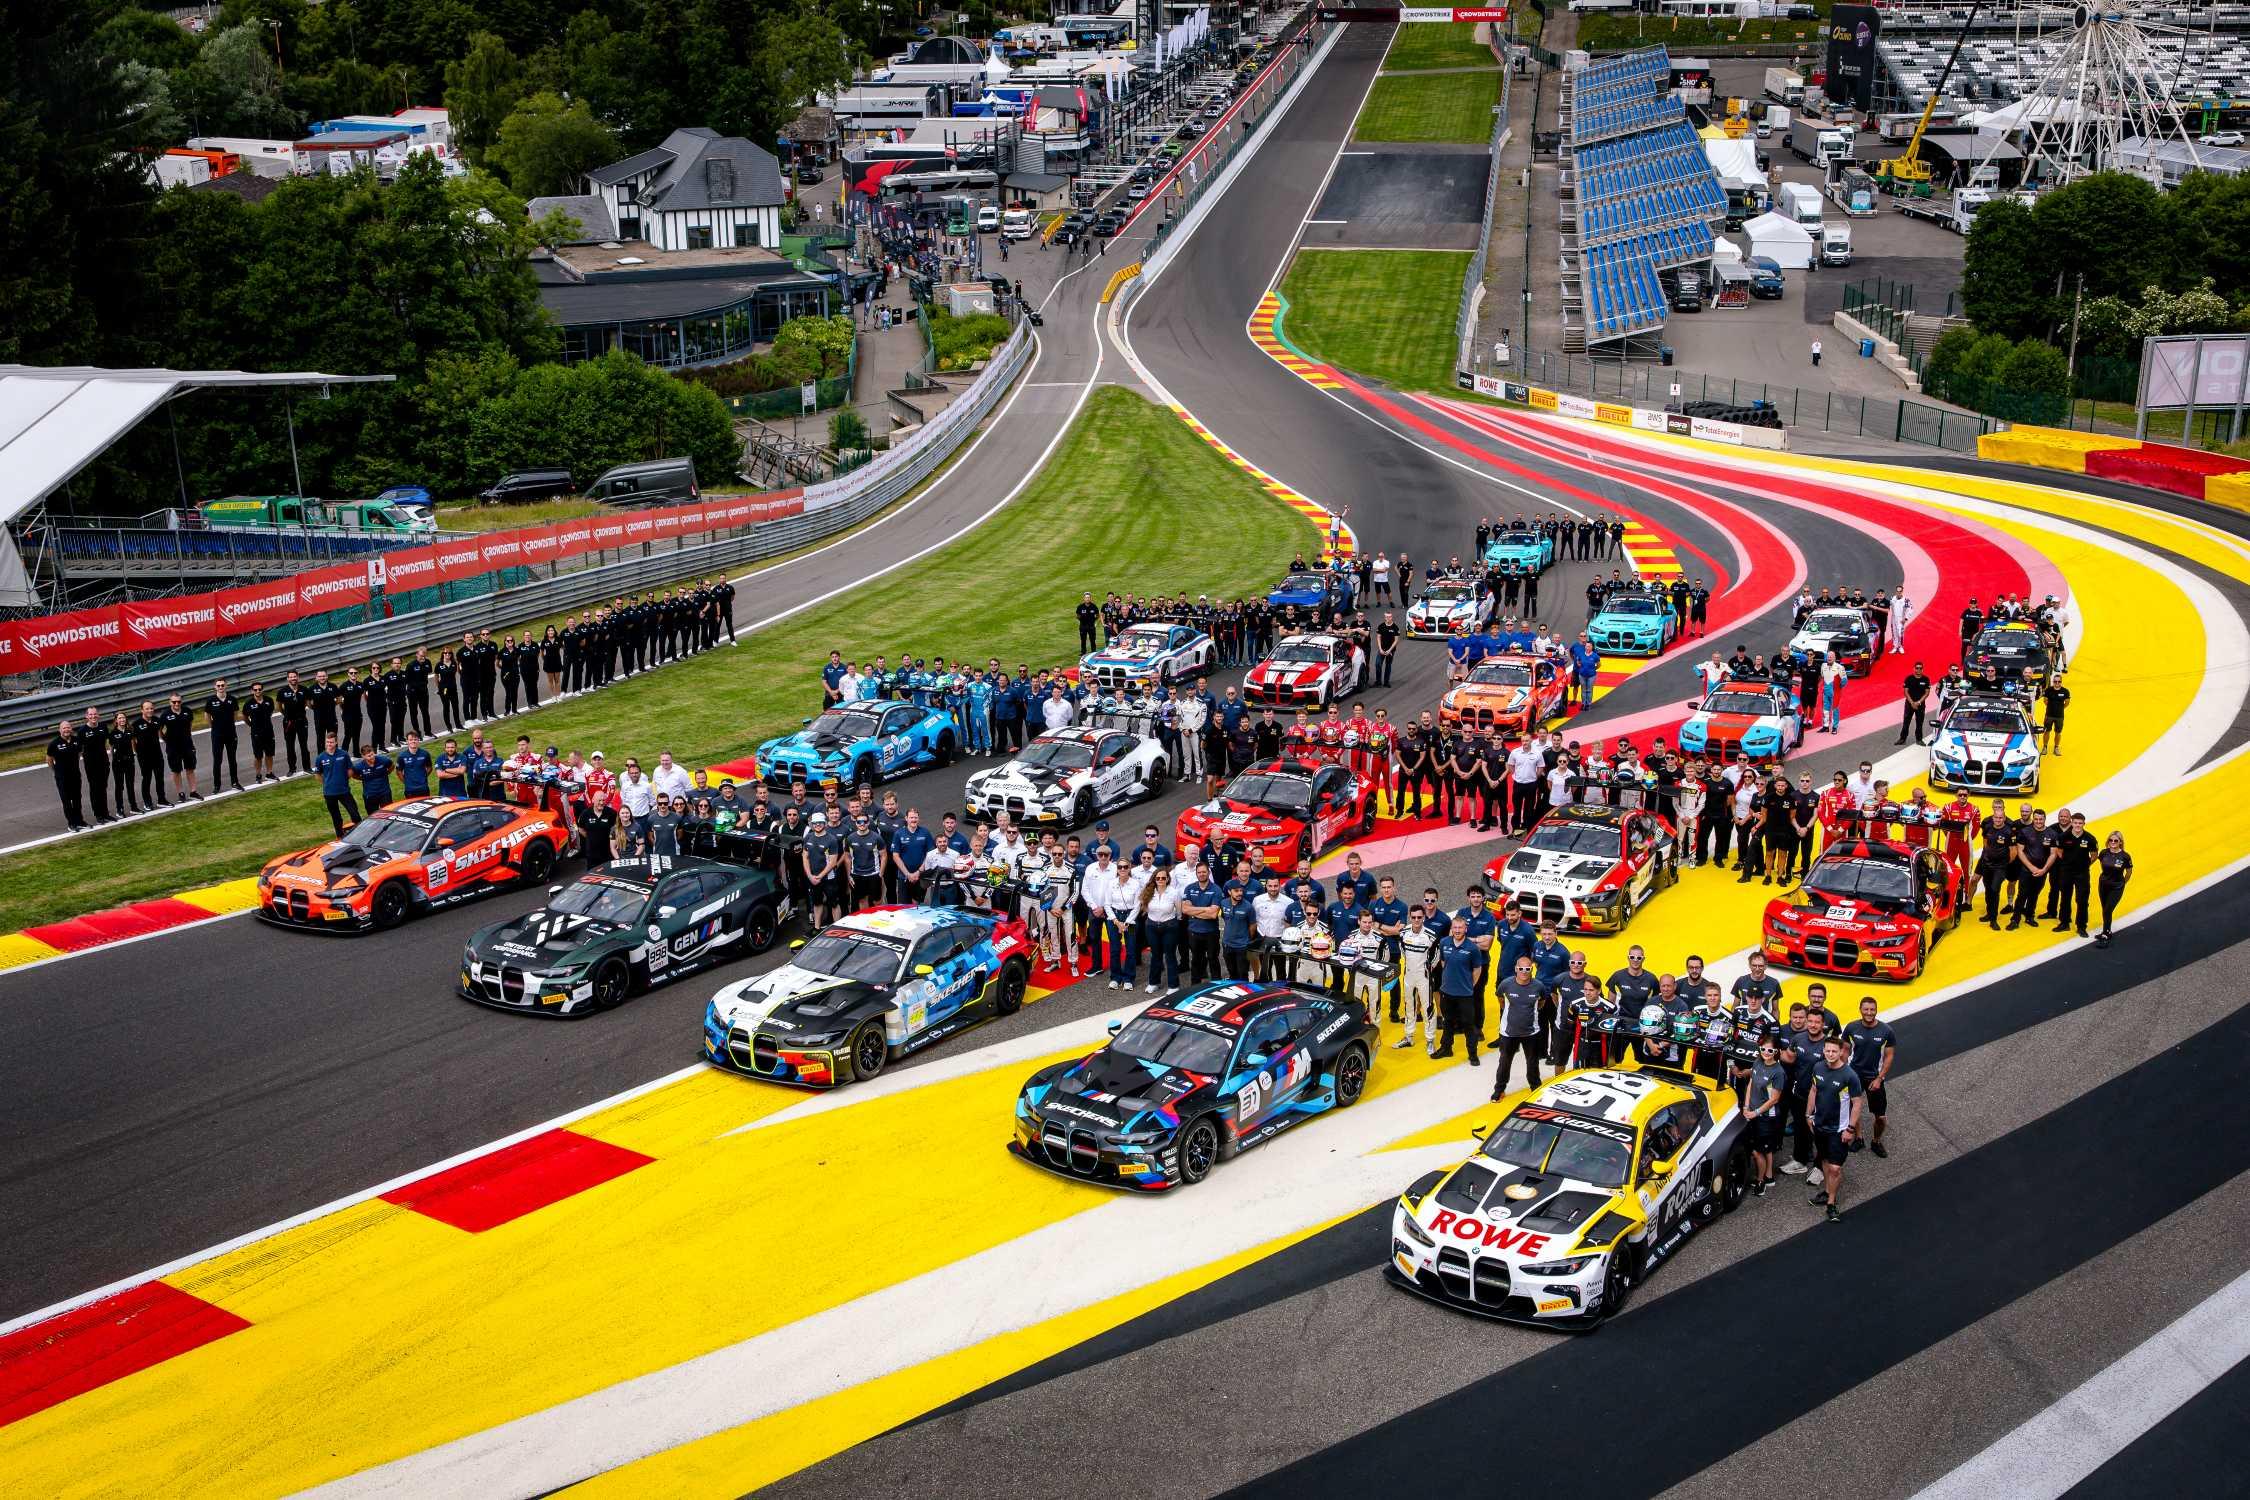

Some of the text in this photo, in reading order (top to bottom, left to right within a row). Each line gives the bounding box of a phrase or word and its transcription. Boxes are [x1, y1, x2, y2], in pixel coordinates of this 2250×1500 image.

[1479, 378, 1498, 391] ROWE
[1532, 392, 1555, 407] PIRELLI
[1598, 406, 1629, 422] PIRELLI
[440, 550, 479, 566] CROWDSTRIKE
[484, 542, 520, 557] CROWDSTRIKE
[390, 559, 435, 577] CROWDSTRIKE
[305, 575, 367, 597] CROWDSTRIKE
[225, 591, 296, 617] CROWDSTRIKE
[136, 607, 215, 630] CROWDSTRIKE
[30, 620, 120, 649] CROWDSTRIKE
[454, 820, 549, 872] SKECHERS
[430, 866, 447, 882] 32
[1852, 859, 1910, 871] WORLD
[1829, 908, 1853, 917] 991
[674, 929, 699, 951] GEN
[849, 935, 906, 951] WORLD
[650, 946, 667, 964] 998
[930, 962, 987, 1007] SKECHERS
[1191, 1001, 1215, 1011] 31
[1146, 1008, 1238, 1036] GT WORLD
[1316, 1013, 1350, 1044] SKECHERS
[1737, 1029, 1760, 1041] ROWE
[1242, 1091, 1257, 1112] 31
[1046, 1102, 1120, 1128] SKECHERS
[1516, 1107, 1634, 1143] GT WORLD
[1121, 1164, 1147, 1173] PIRELLI
[1428, 1208, 1551, 1258] ROWE
[1540, 1300, 1569, 1312] PIRELLI
